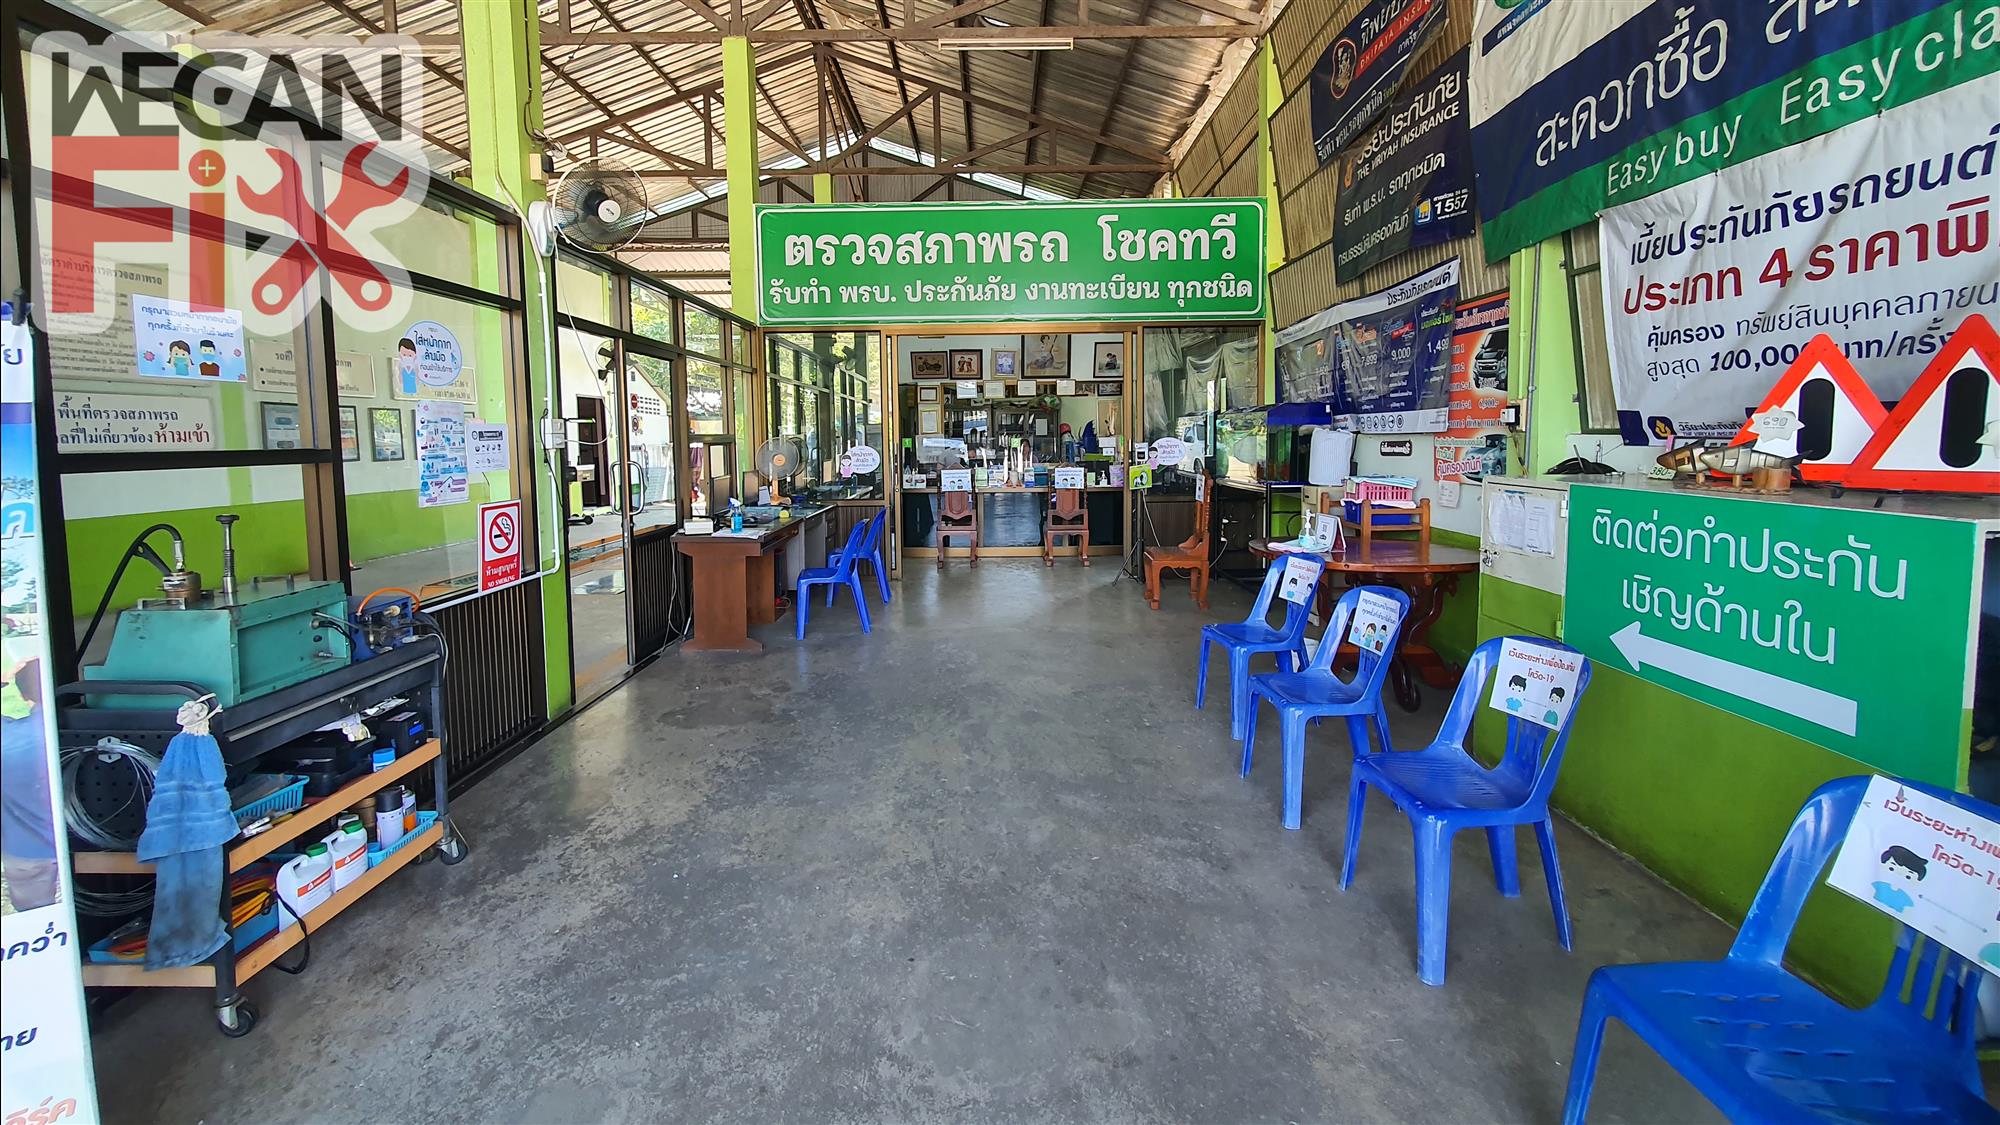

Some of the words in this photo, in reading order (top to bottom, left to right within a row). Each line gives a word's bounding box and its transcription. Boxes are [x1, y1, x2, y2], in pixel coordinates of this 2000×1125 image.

[1535, 4, 1729, 168] สะดวกซื้อ
[1356, 164, 1370, 181] THE
[1400, 100, 1460, 149] INSURANCE
[1605, 141, 1669, 198] Easy
[1674, 113, 1742, 167] buy
[1780, 48, 1902, 125] Easy
[1434, 194, 1469, 215] 1557
[784, 229, 1069, 267] ตรวจสภาพรถ
[1096, 212, 1237, 263] โชคทวี
[1623, 266, 1742, 315] ประเภท
[1758, 246, 1793, 289] 4
[1803, 195, 2000, 282] ราคาพิ
[769, 277, 832, 305] รับทำ
[838, 284, 898, 304] พรบ.
[904, 275, 1017, 303] ประกันภัย
[1024, 273, 1160, 301] งานทะเบียน
[1167, 272, 1254, 308] ทุกชนิด
[1646, 322, 1725, 353] คุ้มครอง
[1646, 355, 1700, 381] สูงสุด
[485, 557, 518, 578] ห้ามสูบบุหรี่
[1592, 508, 1908, 600] ติดต่อทำประกัน
[487, 580, 495, 589] NO
[495, 575, 516, 587] SMOKING
[1621, 574, 1836, 665] เชิญด้านใน
[1527, 667, 1555, 684] โควิด-19
